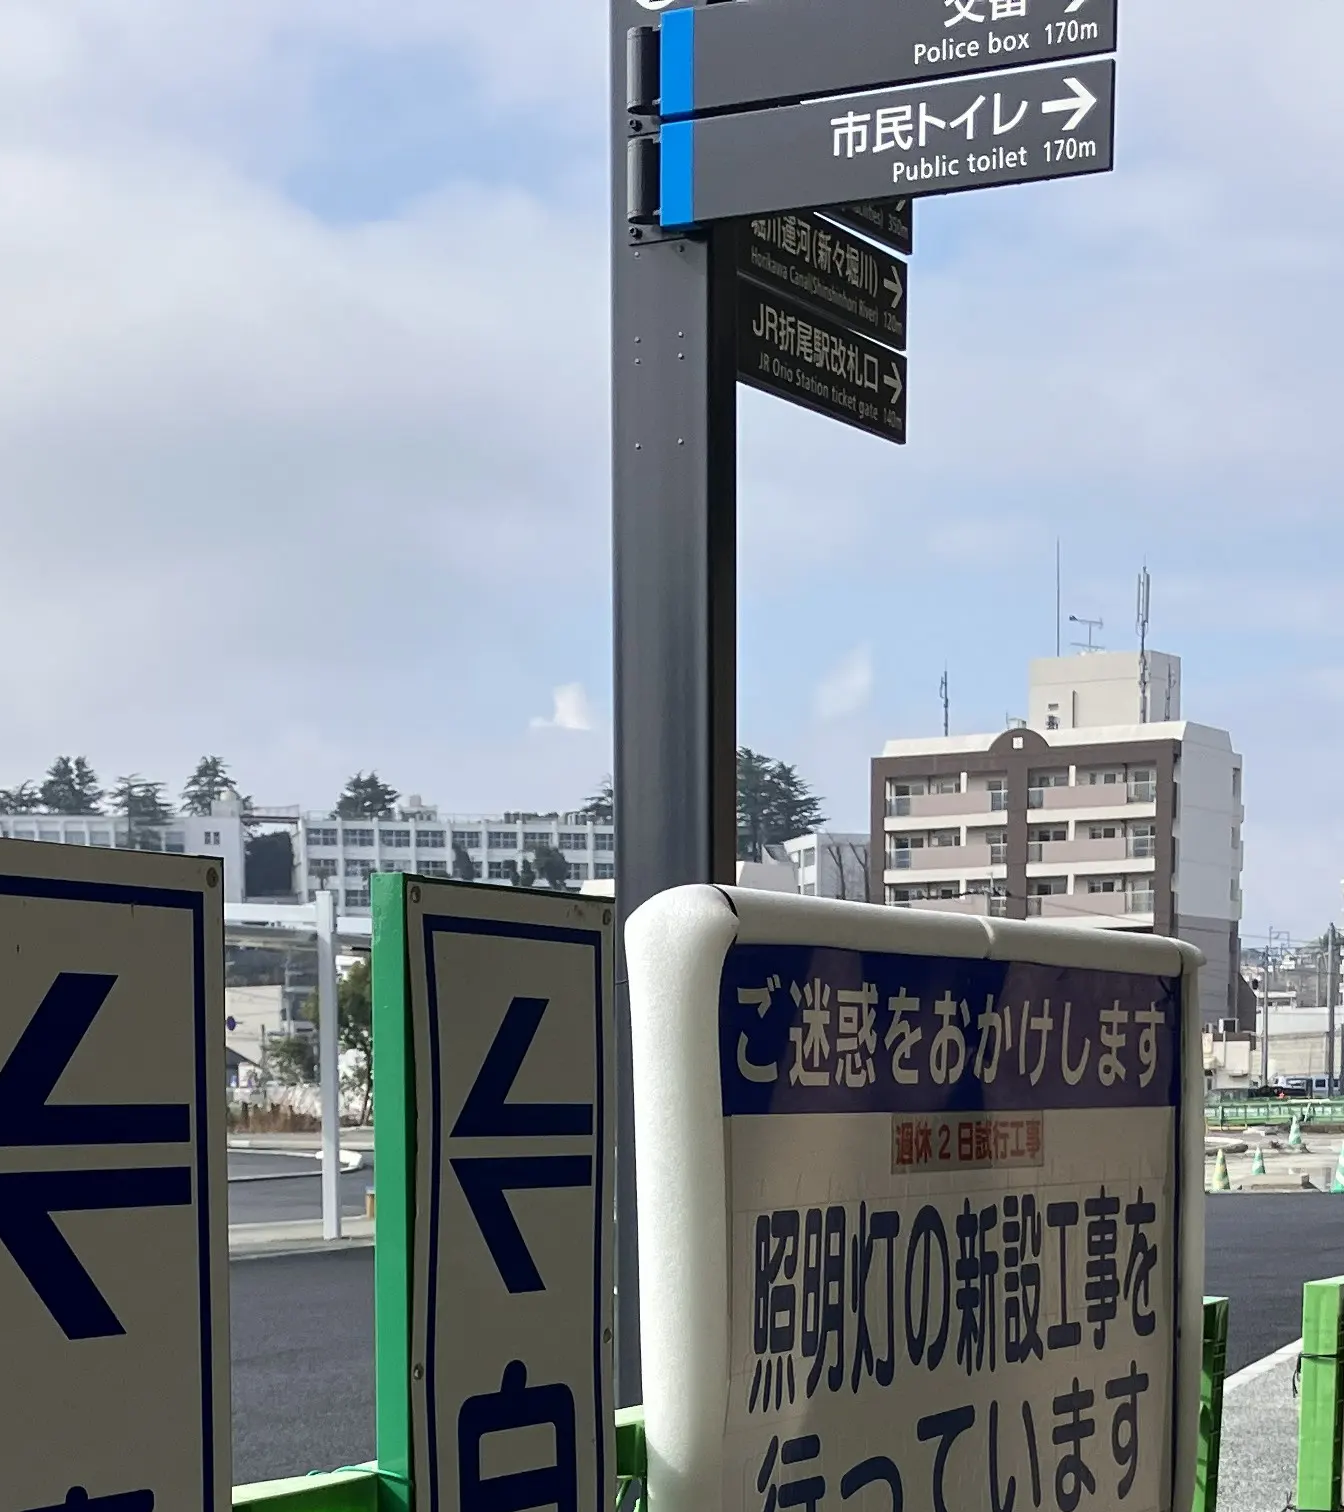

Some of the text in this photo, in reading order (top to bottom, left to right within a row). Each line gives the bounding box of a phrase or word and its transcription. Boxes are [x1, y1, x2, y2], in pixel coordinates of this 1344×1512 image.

[914, 20, 1098, 65] Police box 170m
[830, 93, 1029, 158] 市民トイレ
[892, 138, 1097, 183] Public toilet 170m
[752, 303, 879, 394] JR折尾駅改札口
[758, 352, 770, 372] JR
[772, 358, 794, 383] Orio
[795, 368, 830, 400] Station
[831, 385, 857, 413] ticket
[858, 401, 879, 421] gate
[736, 973, 1166, 1088] ご迷惑をおかけします
[748, 1185, 1158, 1415] 照明灯の新設工事を
